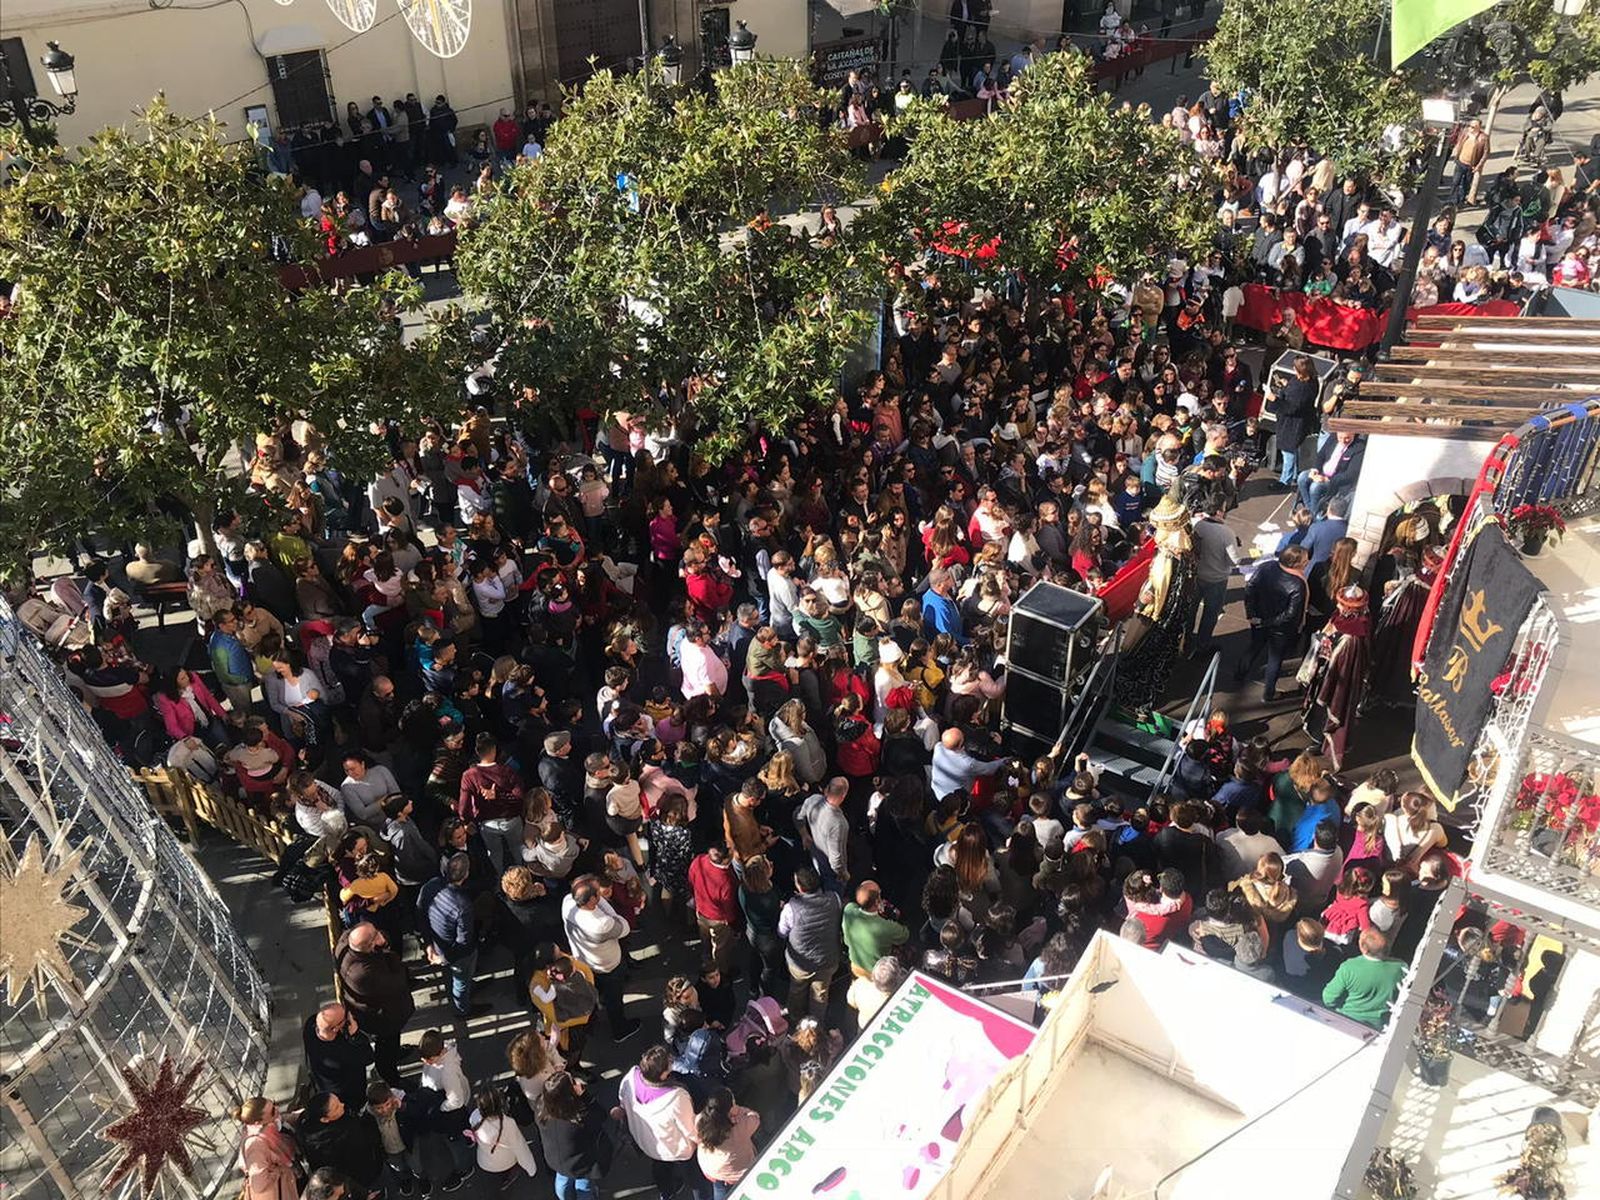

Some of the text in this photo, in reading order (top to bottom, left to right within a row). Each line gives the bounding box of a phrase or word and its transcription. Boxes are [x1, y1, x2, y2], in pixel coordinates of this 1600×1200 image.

[827, 46, 875, 61] CASTAÑAS DE
[756, 983, 932, 1190] ATRACCIONES ARCO
